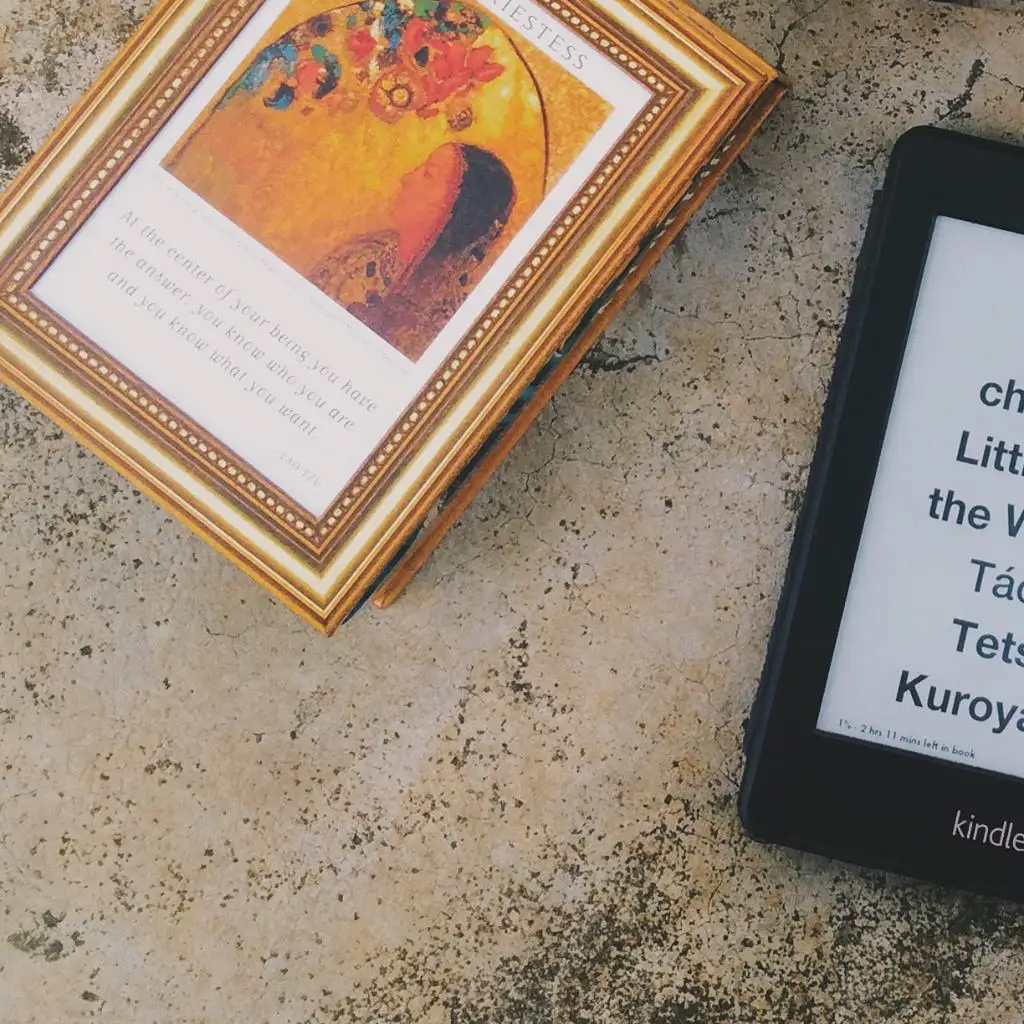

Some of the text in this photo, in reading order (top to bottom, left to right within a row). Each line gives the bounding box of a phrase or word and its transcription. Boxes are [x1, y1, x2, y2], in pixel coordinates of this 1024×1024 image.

[107, 270, 137, 297] and
[134, 295, 165, 320] you
[168, 316, 208, 351] know
[209, 350, 247, 382] what
[244, 381, 275, 407] you
[110, 236, 135, 259] the
[192, 303, 223, 329] you
[225, 324, 264, 360] know
[267, 357, 297, 385] who
[294, 383, 325, 409] you
[327, 406, 355, 431] are
[119, 208, 377, 413] At the center of your being you have
[928, 488, 991, 530] the
[860, 724, 867, 733] 2
[869, 725, 882, 737] hrs
[886, 730, 897, 740] 11
[900, 735, 921, 746] mins
[923, 738, 938, 750] left
[941, 742, 950, 752] in
[951, 745, 976, 759] book
